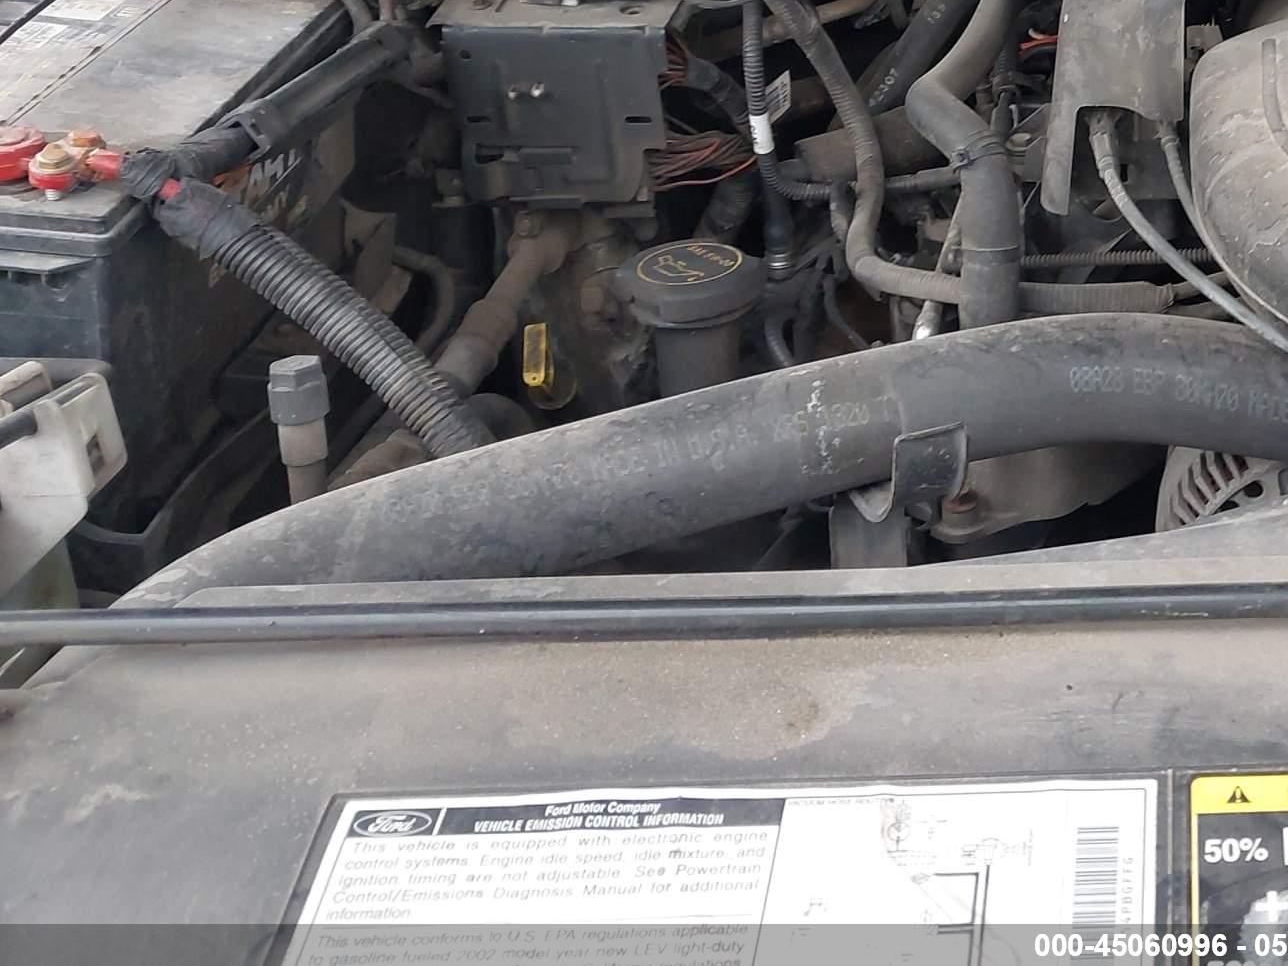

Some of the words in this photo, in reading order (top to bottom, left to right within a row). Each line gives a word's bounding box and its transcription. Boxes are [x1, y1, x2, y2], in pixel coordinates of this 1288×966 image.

[545, 805, 571, 816] Ford
[573, 803, 605, 814] Motor
[608, 802, 661, 814] Company
[368, 815, 417, 833] Ford
[474, 819, 522, 833] VEHICLE
[525, 815, 583, 831] EMISSION
[585, 814, 639, 828] CONTROL
[643, 813, 724, 827] INFORMATION
[353, 841, 386, 853] This
[398, 840, 455, 851] vehicle
[466, 841, 479, 850] is
[491, 836, 567, 852] equipped
[578, 836, 610, 846] with
[622, 832, 702, 845] electronic
[713, 832, 768, 845] engine
[1204, 837, 1269, 865] 50%
[345, 858, 399, 871] control
[480, 854, 534, 868] Engine
[541, 853, 567, 864] idle
[634, 849, 661, 860] idle
[736, 846, 765, 858] and
[338, 874, 399, 889] ignition
[408, 872, 456, 887] timing
[466, 874, 493, 883] are
[502, 871, 528, 882] not
[635, 866, 666, 878] See
[675, 864, 761, 876] Powertrain
[332, 888, 484, 904] Control/Emissions
[493, 886, 573, 901] Diagnosis
[583, 883, 642, 896] Manual
[650, 882, 671, 893] for
[680, 879, 759, 892] additional
[318, 935, 348, 948] This
[352, 934, 408, 947] vehicle
[412, 930, 482, 944] conforms
[489, 931, 504, 942] to
[544, 929, 576, 941] EPA
[582, 927, 666, 942] regulations
[672, 924, 748, 938] applicable
[308, 953, 324, 965] to
[329, 951, 397, 966] gasoline
[402, 951, 451, 963] fueled
[457, 949, 497, 961] 2002
[503, 946, 549, 960] model
[556, 948, 589, 960] year
[599, 947, 627, 957] new
[634, 944, 667, 956] LEV
[674, 941, 744, 955] light-duty
